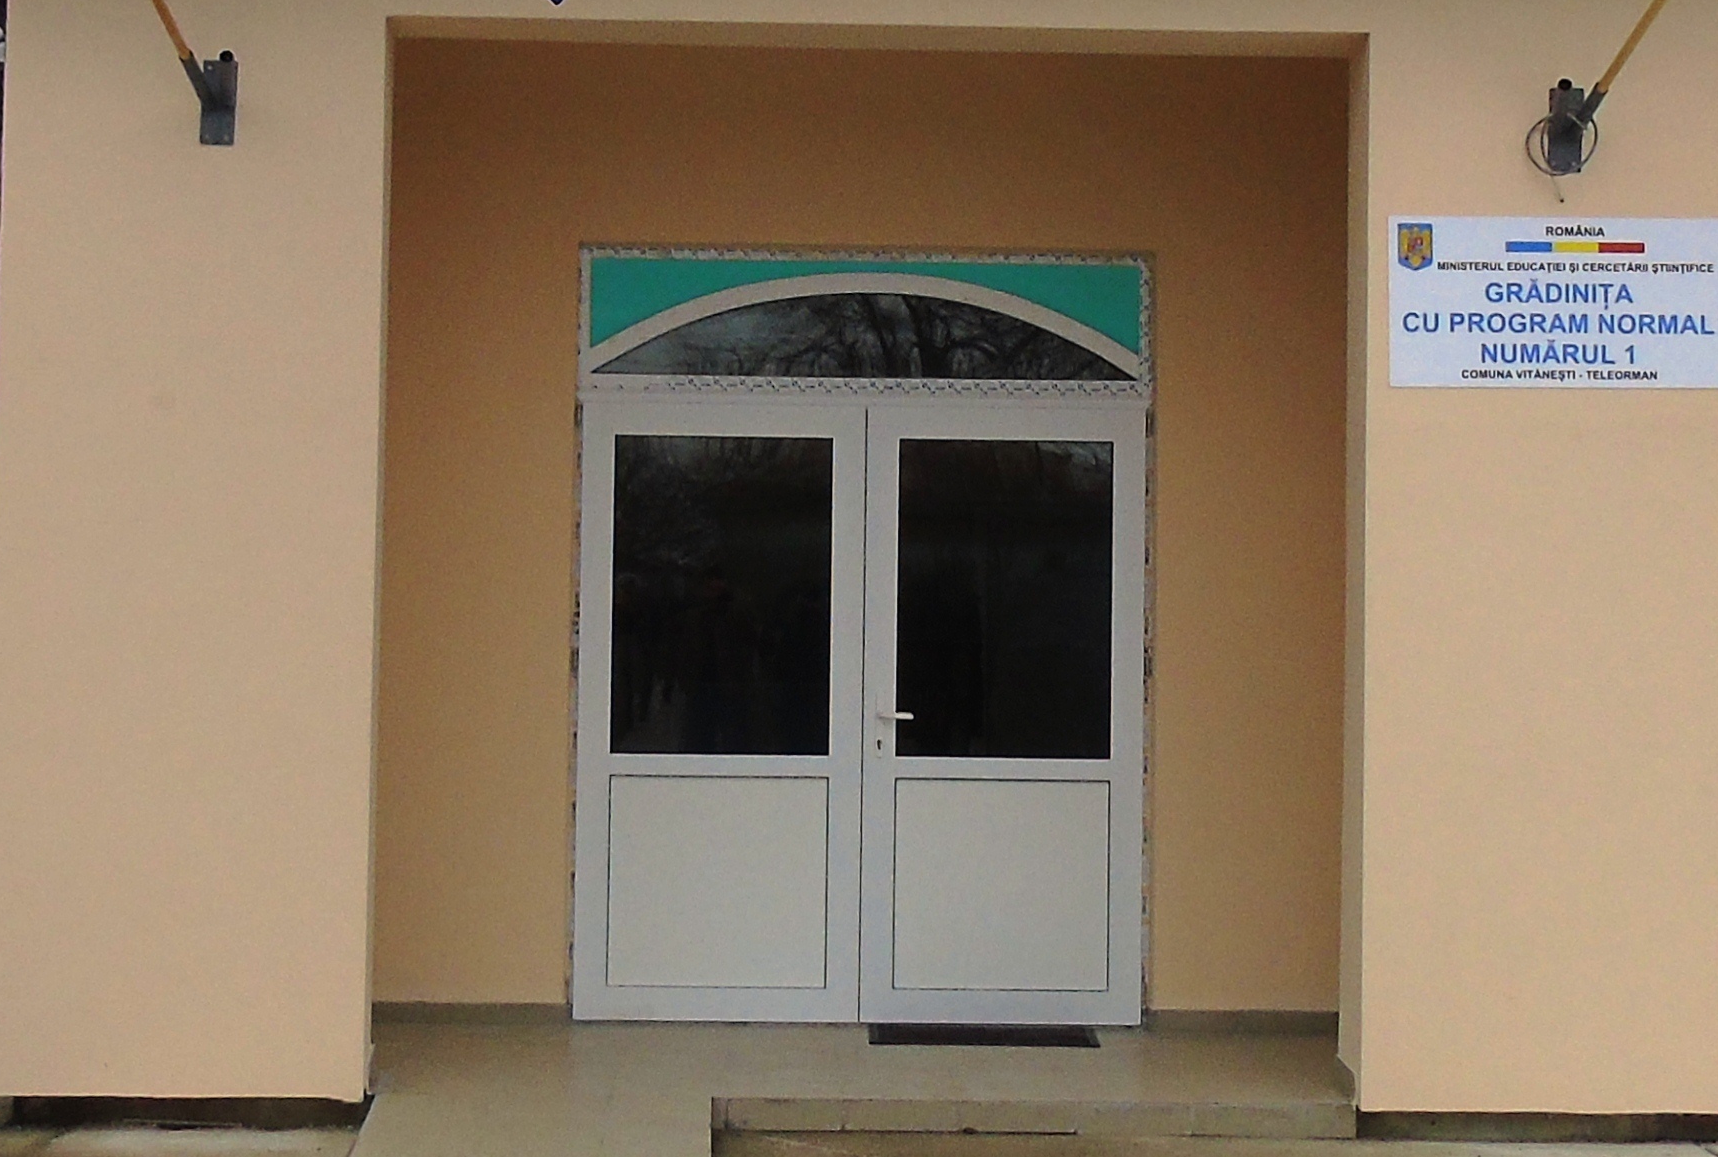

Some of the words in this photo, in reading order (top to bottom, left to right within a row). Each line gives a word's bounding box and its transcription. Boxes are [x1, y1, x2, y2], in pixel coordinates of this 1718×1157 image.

[1545, 224, 1605, 237] ROMÂNIA
[1437, 261, 1504, 272] MINISTERUL
[1402, 312, 1440, 333] CU
[1450, 312, 1589, 334] PROGRAM
[1597, 313, 1715, 335] NORMAL
[1480, 339, 1616, 365] NUMĂRUL
[1624, 344, 1636, 364] 1
[1461, 369, 1513, 380] COMUNA
[1587, 370, 1658, 381] TELEORMAN
